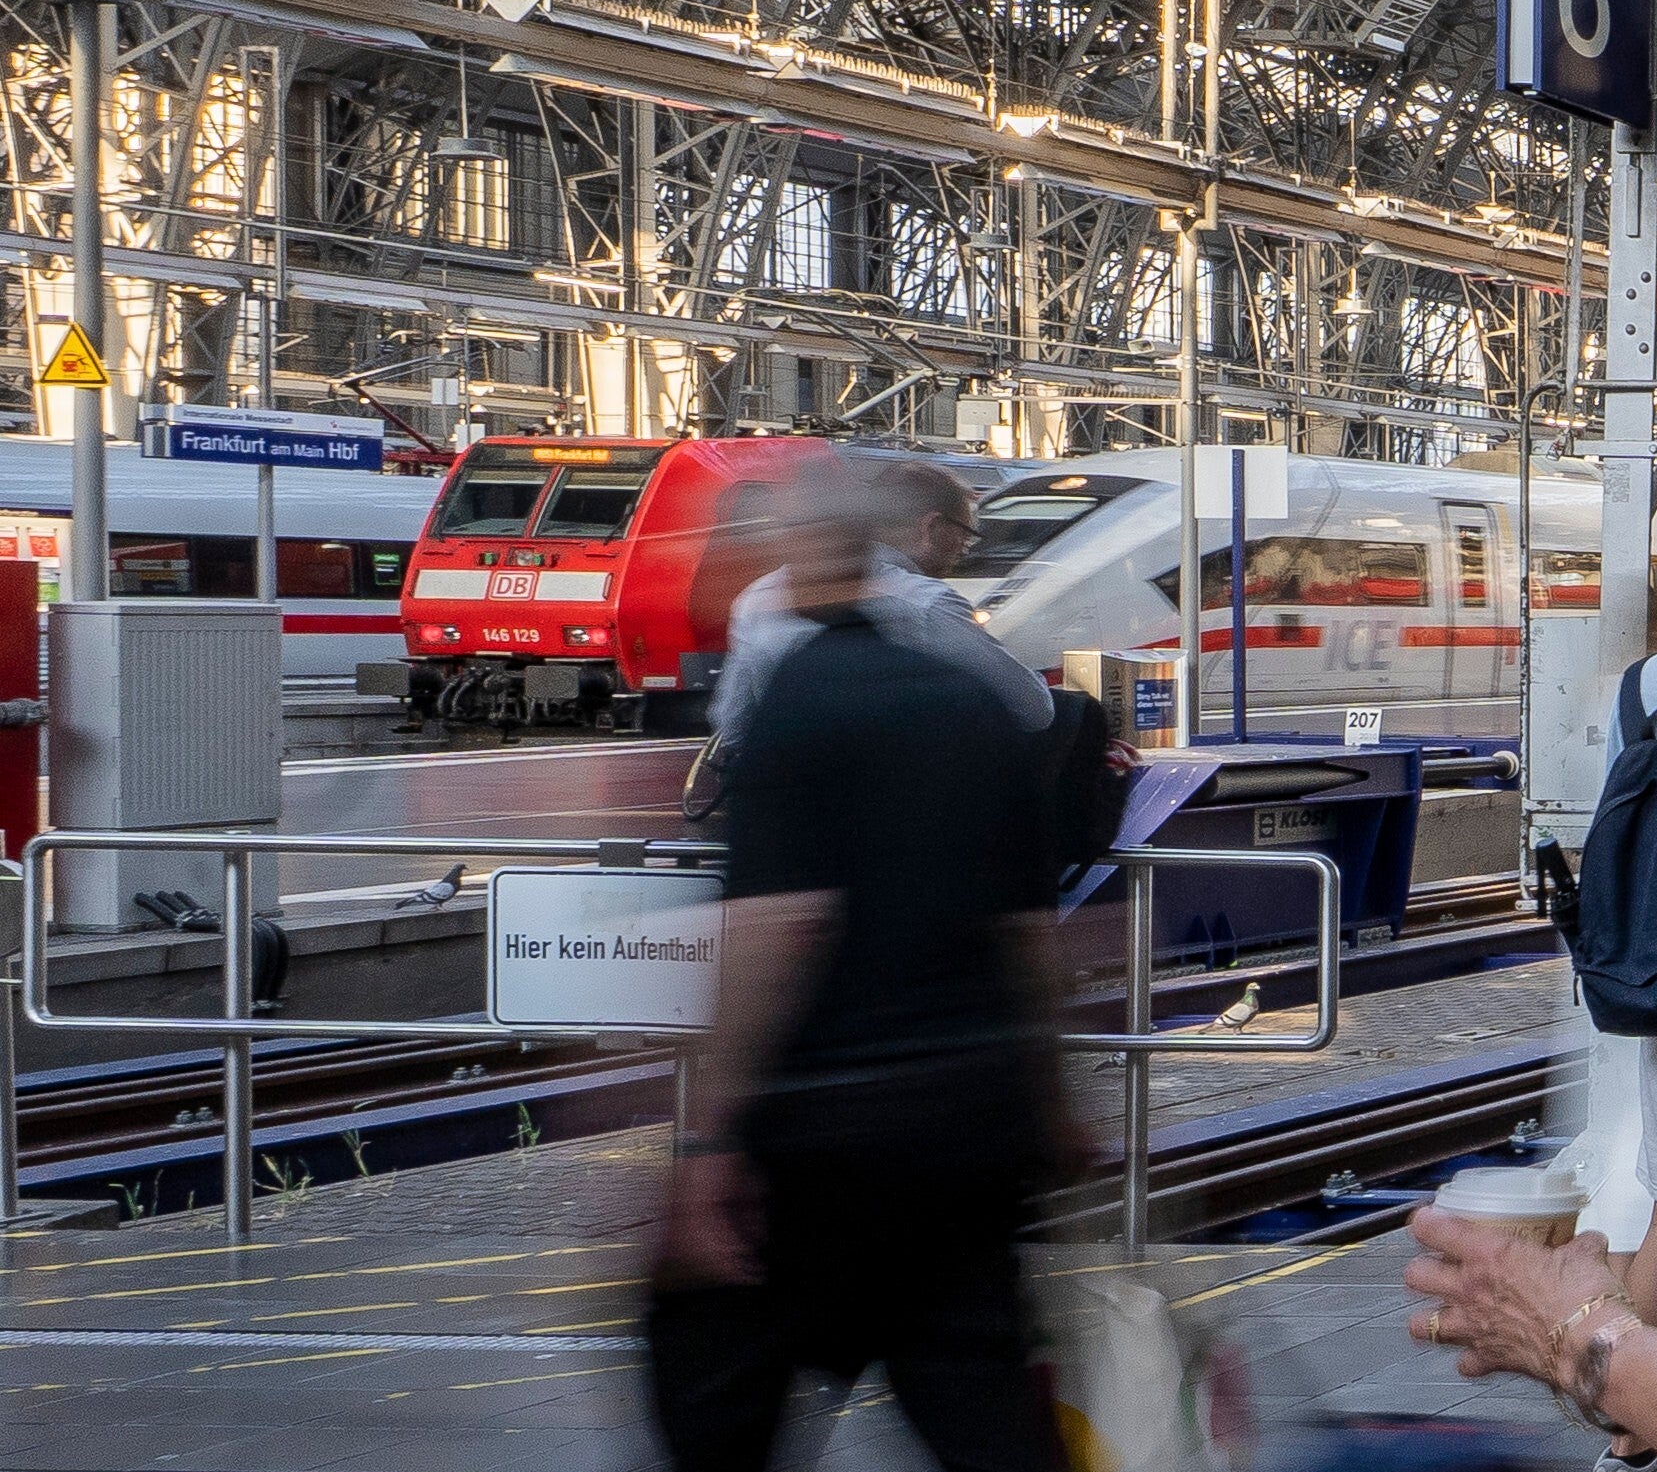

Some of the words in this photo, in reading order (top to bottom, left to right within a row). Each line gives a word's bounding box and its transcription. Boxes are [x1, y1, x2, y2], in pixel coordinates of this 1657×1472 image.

[181, 431, 265, 454] Frankfurt
[270, 443, 291, 456] am
[294, 444, 324, 458] Main
[328, 442, 360, 461] Hbf
[496, 576, 528, 595] DB
[483, 628, 510, 643] 146
[513, 629, 540, 643] 129
[1323, 620, 1397, 671] ICE
[1348, 712, 1379, 728] 207
[506, 934, 552, 959] Hier
[559, 934, 605, 959] kein
[612, 935, 714, 963] Aufenthalt!
